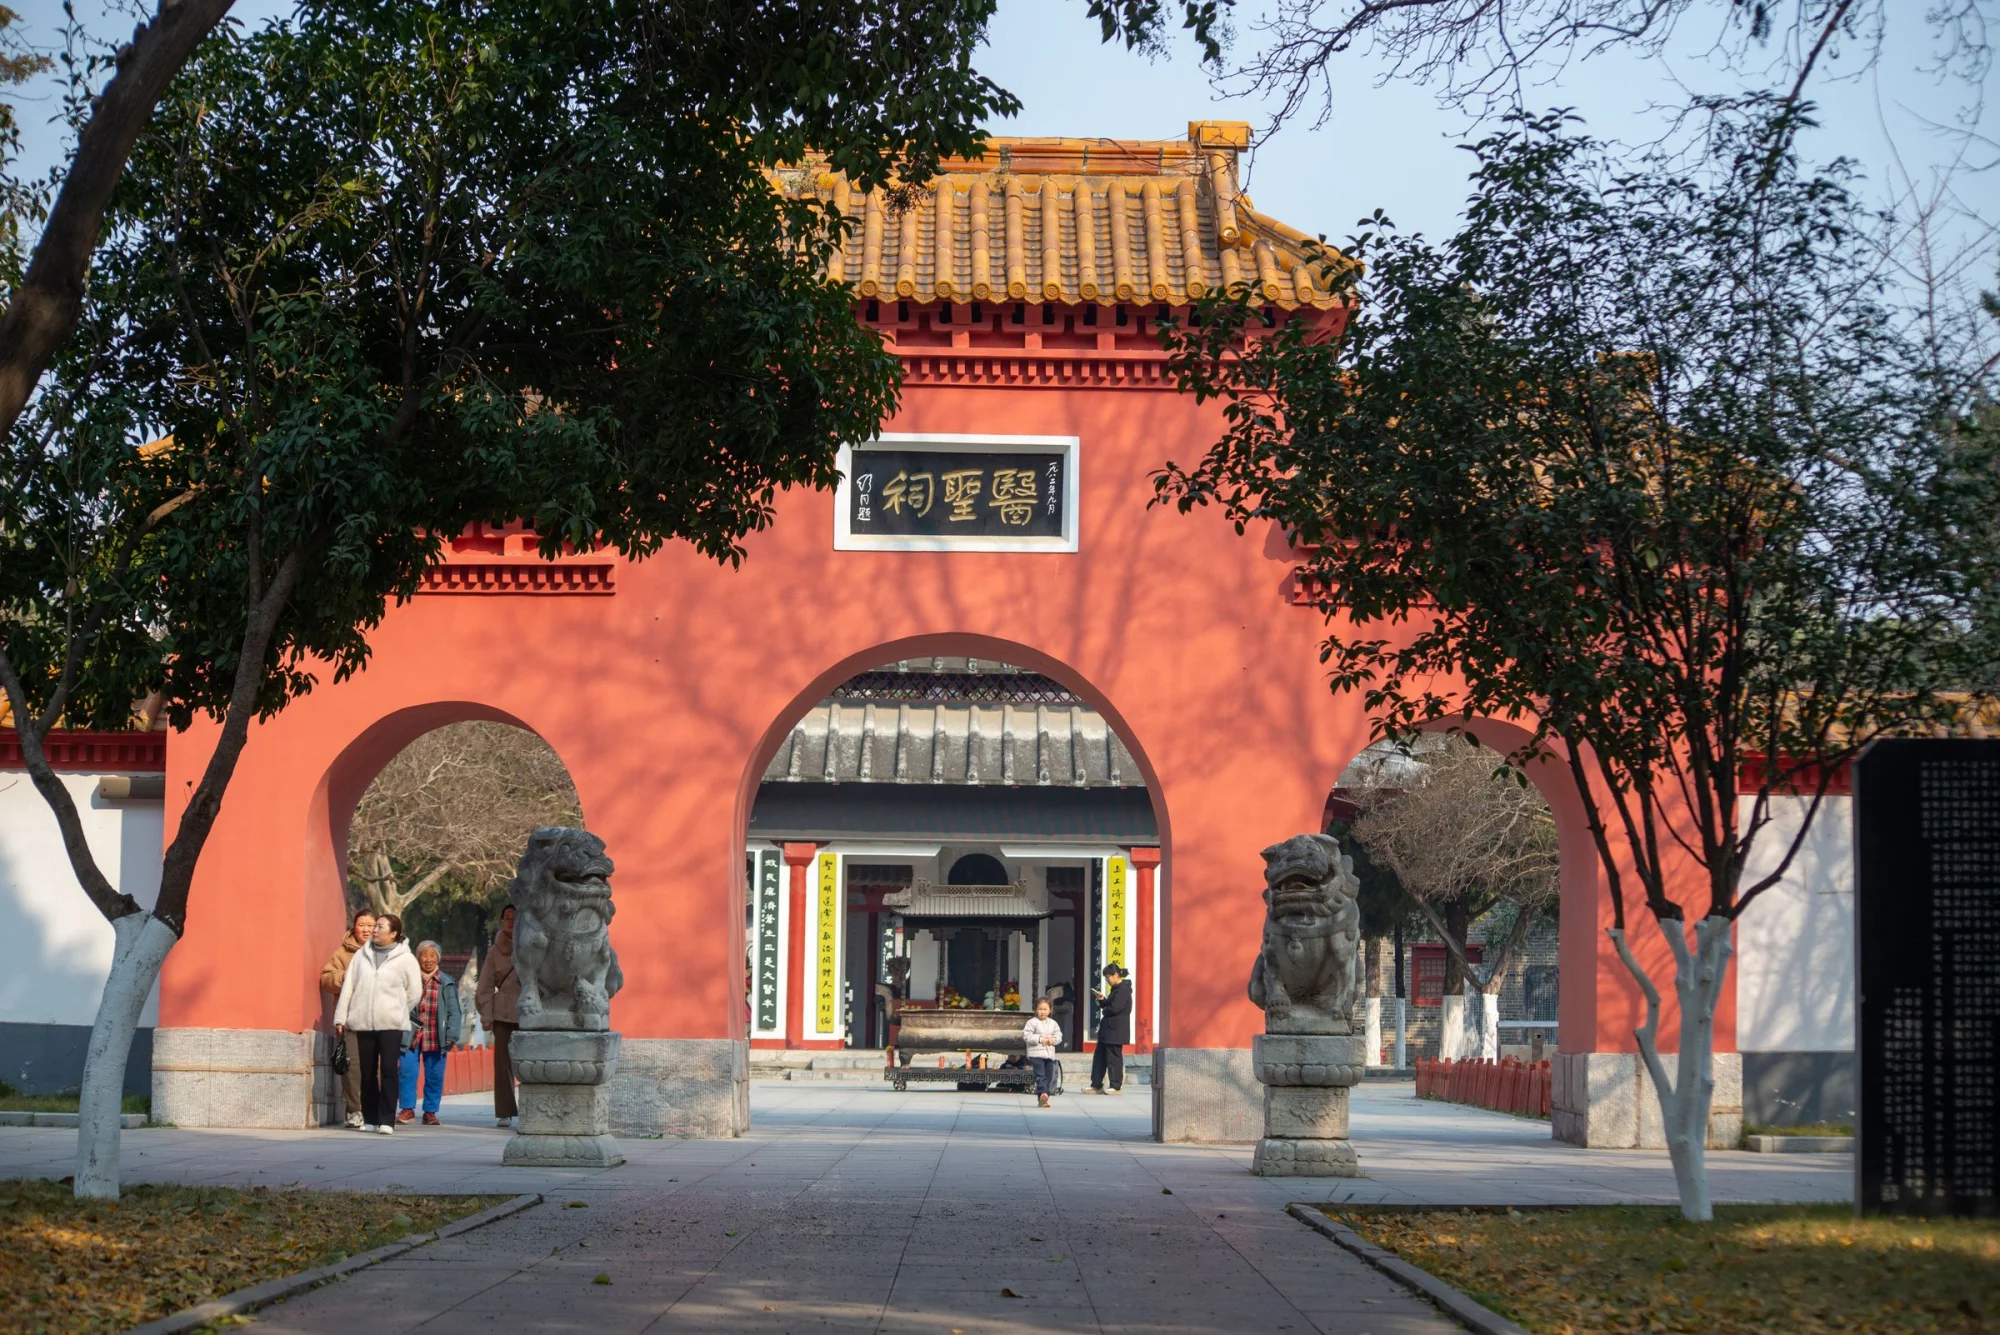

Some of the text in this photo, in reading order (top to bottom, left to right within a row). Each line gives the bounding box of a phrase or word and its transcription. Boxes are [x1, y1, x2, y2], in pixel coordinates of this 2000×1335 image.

[1045, 461, 1059, 516] 一九八二年九月
